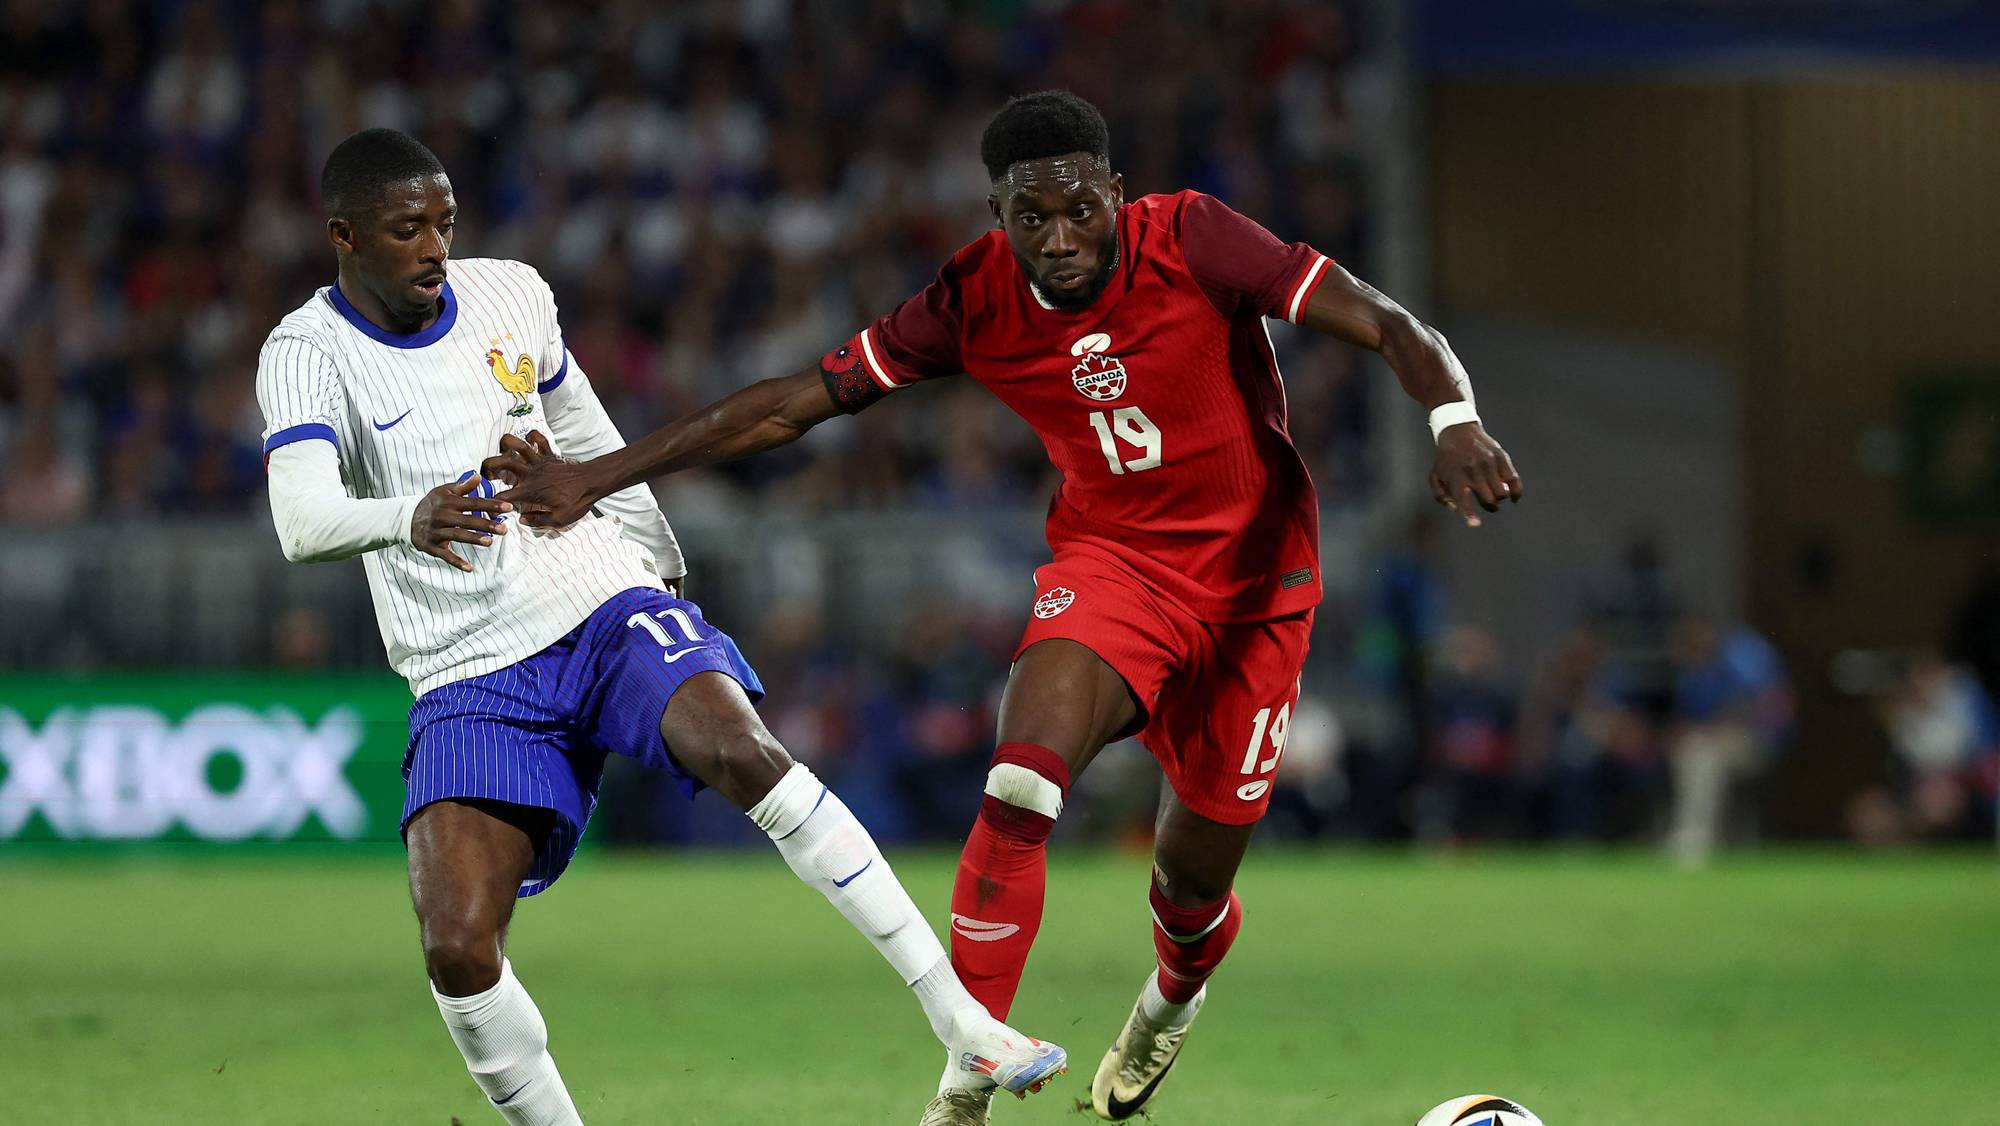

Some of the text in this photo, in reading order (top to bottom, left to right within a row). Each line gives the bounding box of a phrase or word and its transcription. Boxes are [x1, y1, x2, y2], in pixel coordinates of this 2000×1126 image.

[1075, 370, 1124, 387] CANADA
[1089, 406, 1162, 475] 19
[626, 608, 704, 647] 11
[1036, 598, 1071, 608] CANADA
[1240, 701, 1290, 775] 19
[0, 703, 368, 840] XBOX
